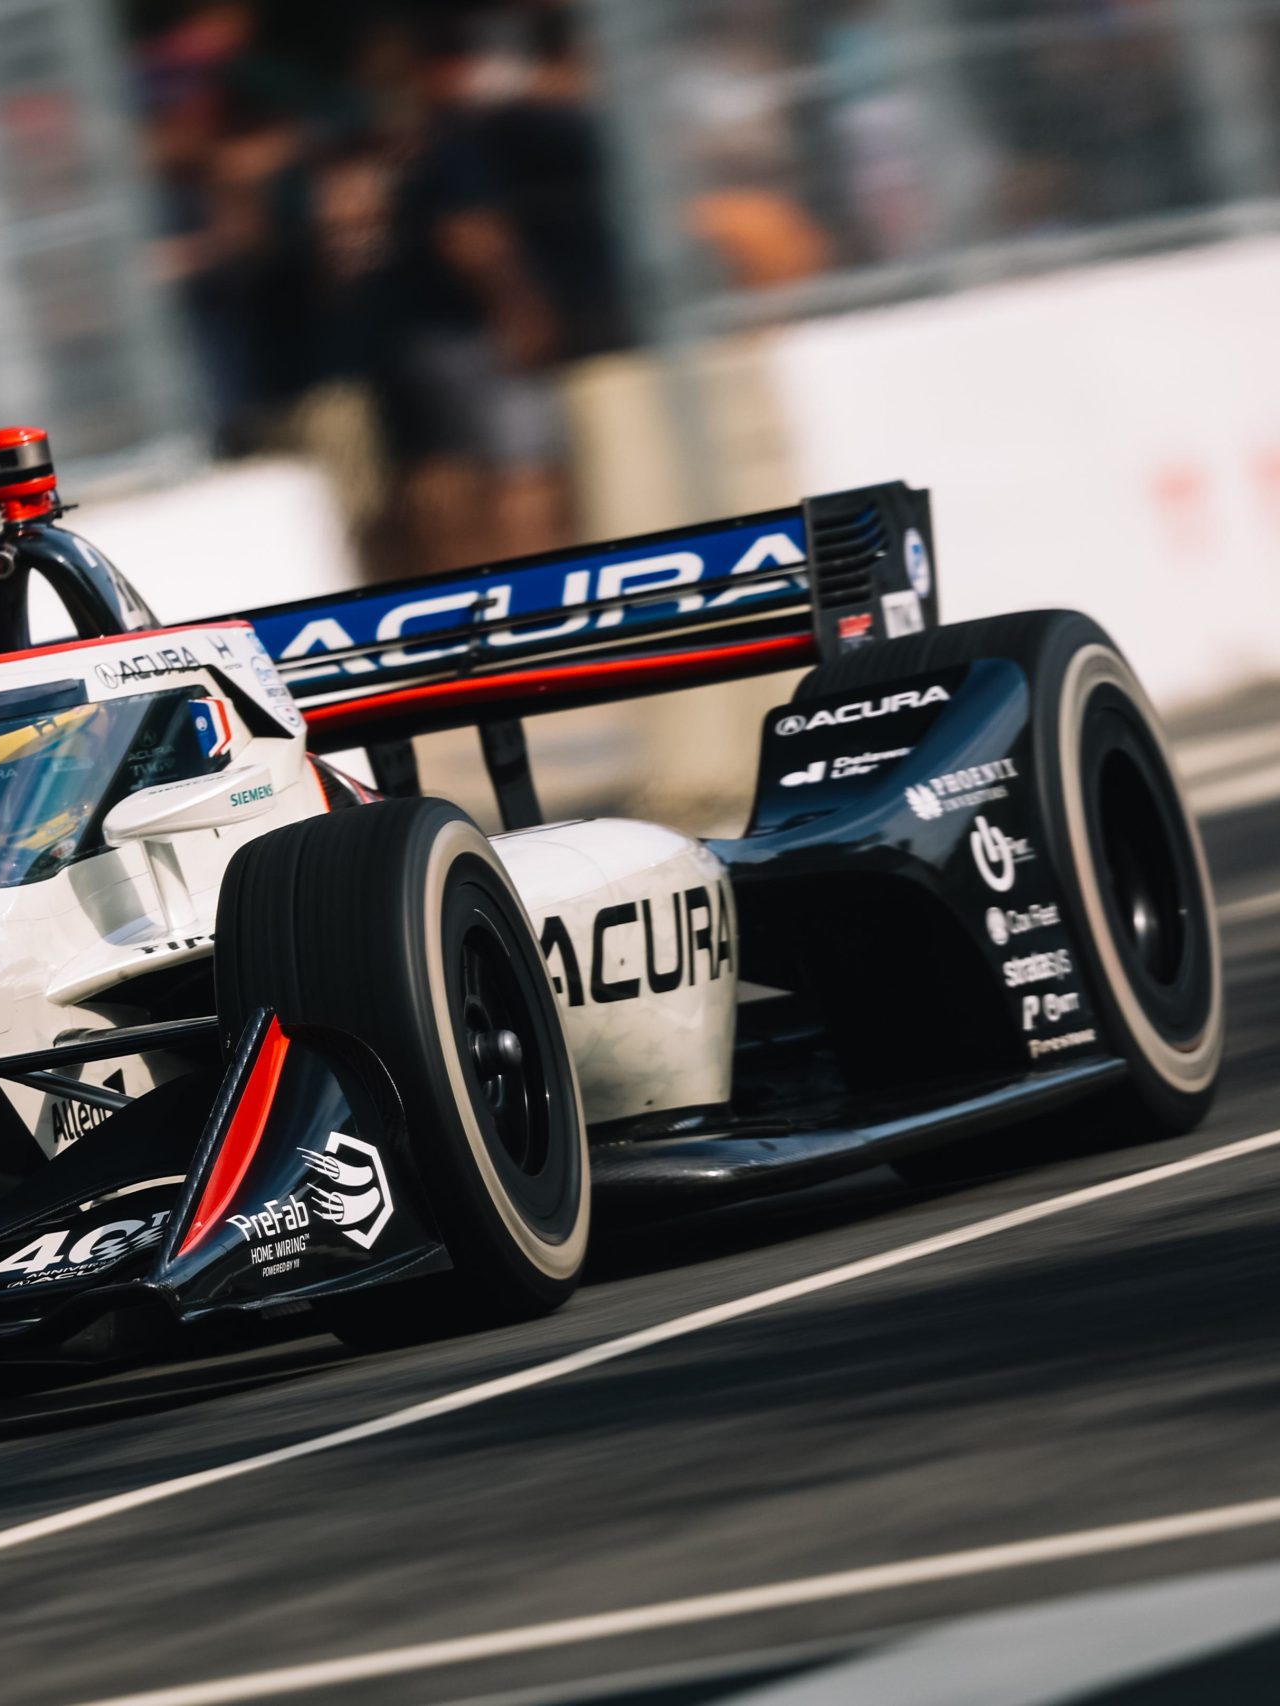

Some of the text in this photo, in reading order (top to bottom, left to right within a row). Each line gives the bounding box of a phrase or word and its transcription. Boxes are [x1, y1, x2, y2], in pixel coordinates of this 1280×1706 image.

[275, 533, 811, 683] ACURA
[119, 646, 200, 684] ACURA
[804, 685, 951, 730] ACURA
[230, 784, 273, 807] SIEMENS
[539, 879, 734, 1007] ACURA
[225, 1194, 310, 1241] PreFab
[250, 1243, 274, 1265] HOME
